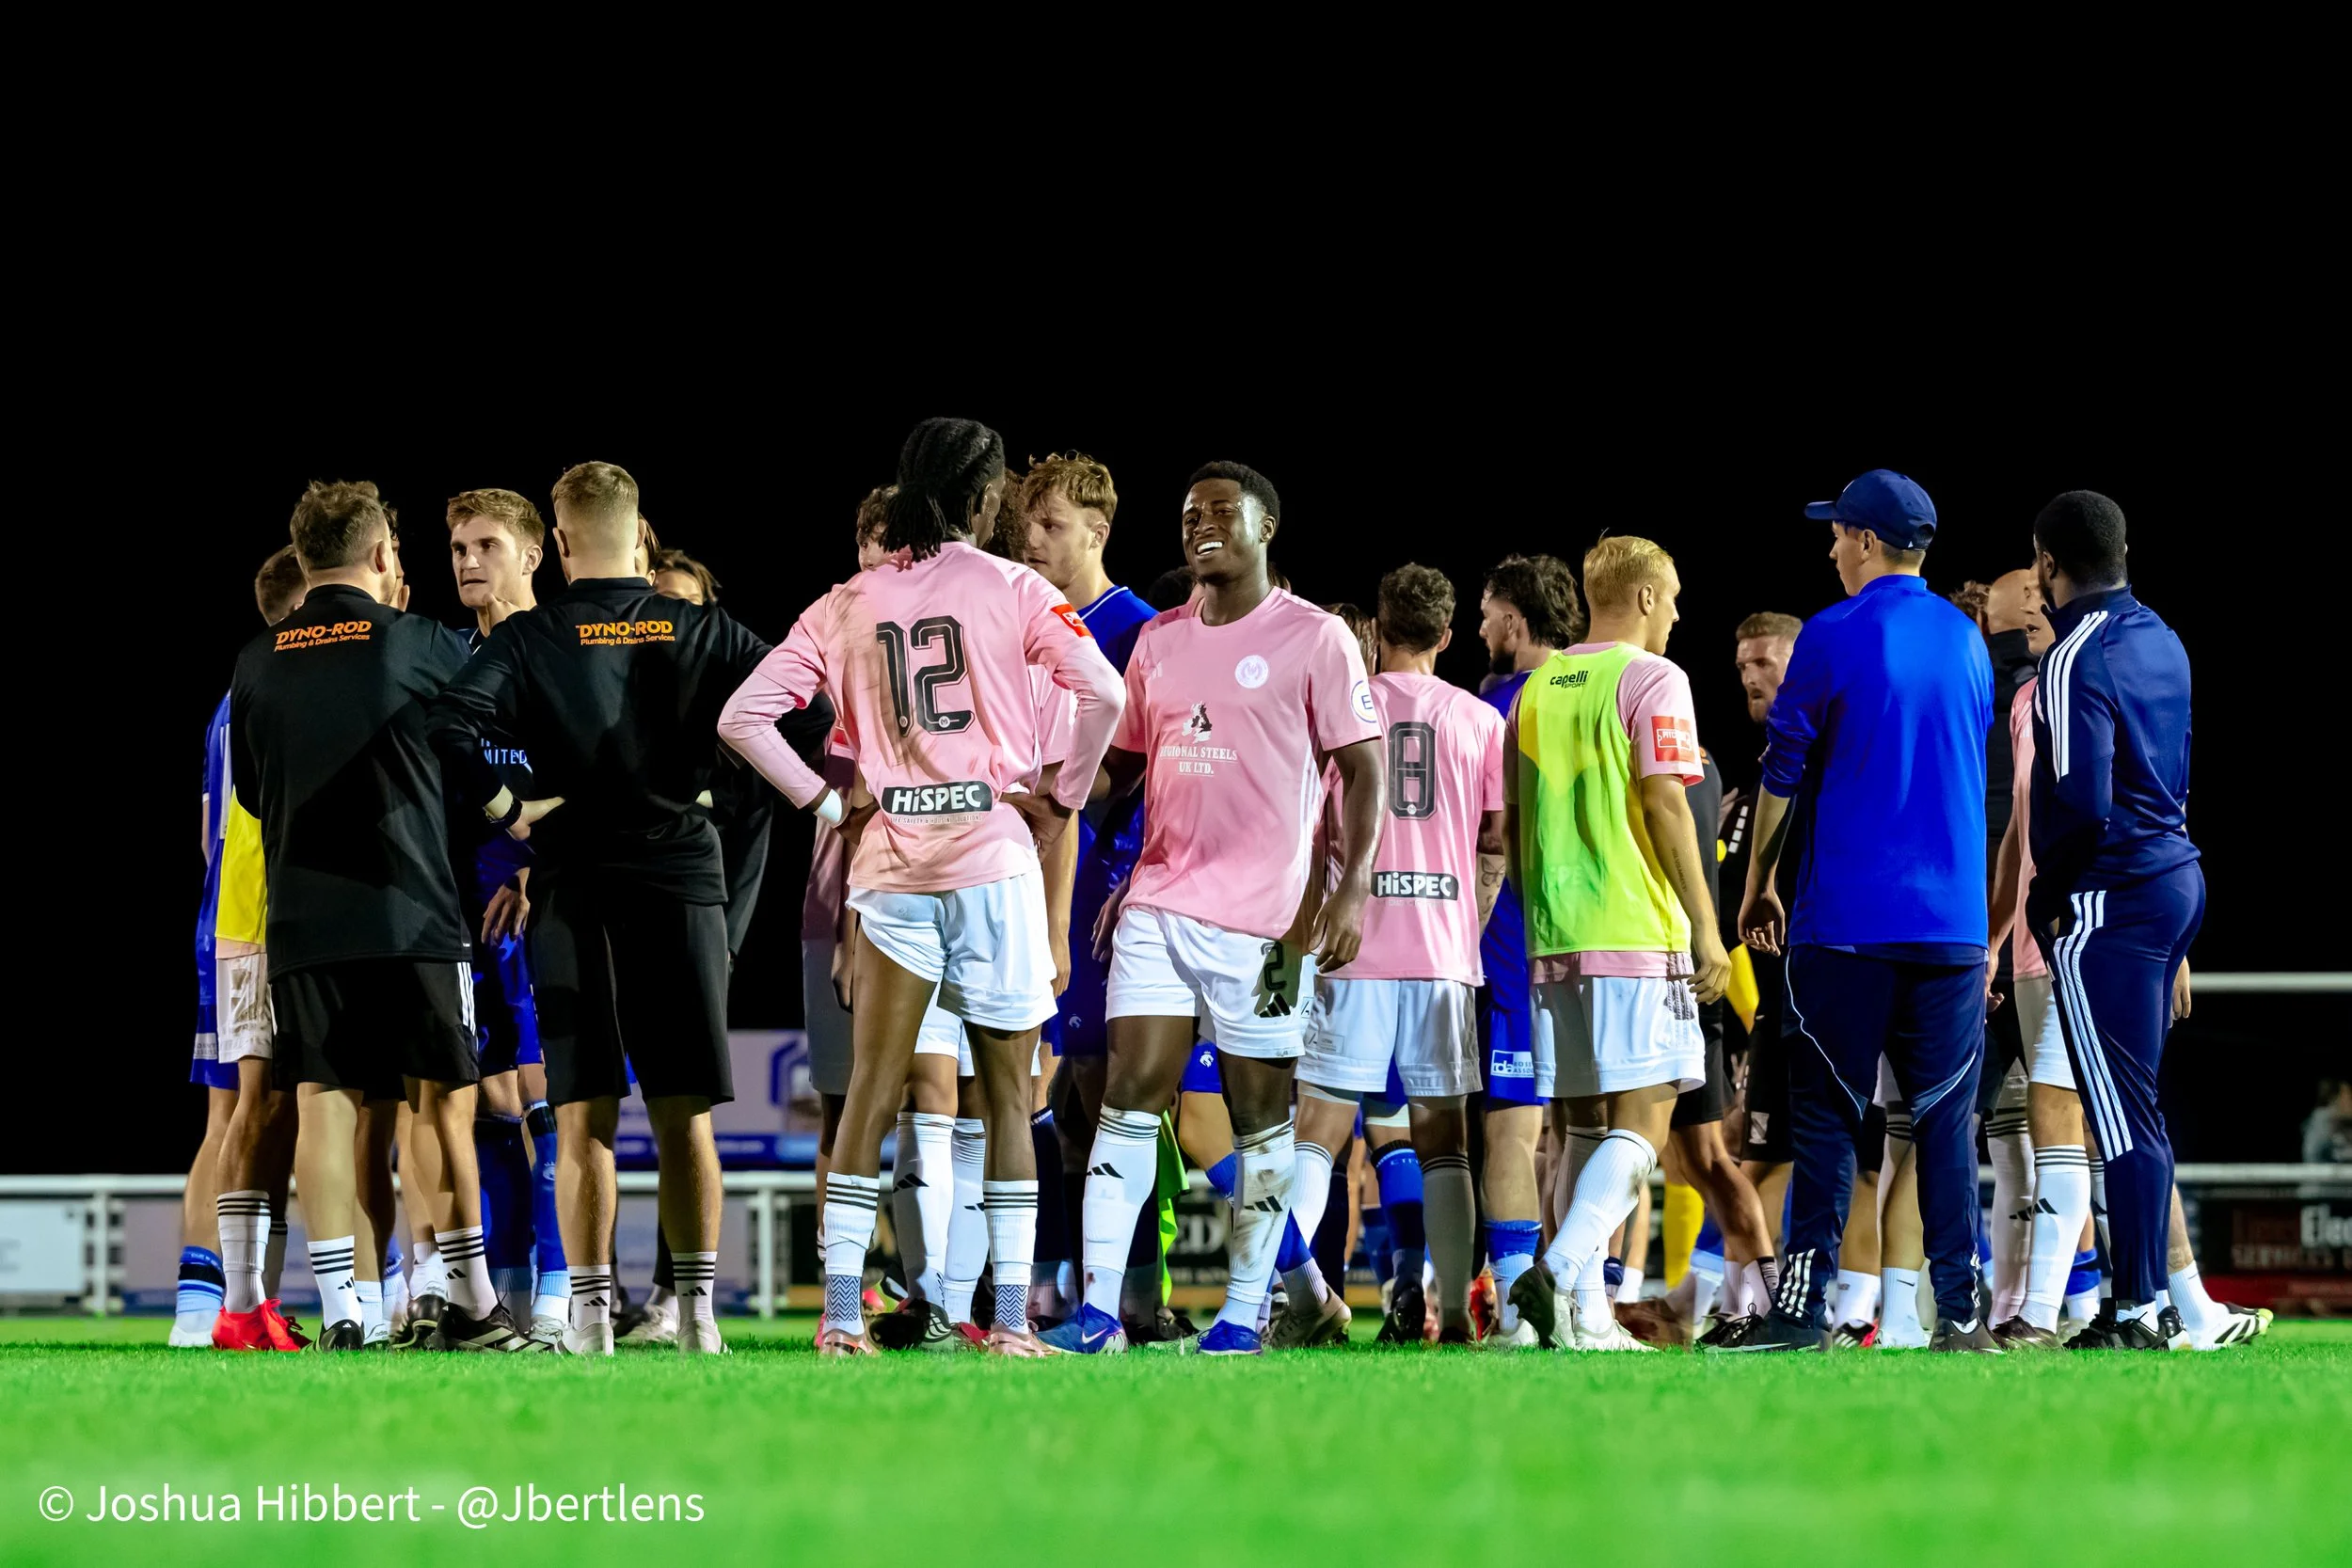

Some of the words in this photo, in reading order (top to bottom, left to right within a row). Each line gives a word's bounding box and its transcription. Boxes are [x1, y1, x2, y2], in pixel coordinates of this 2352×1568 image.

[276, 621, 372, 644] DYNO-ROD
[575, 621, 673, 638] DYNO-ROD
[274, 641, 308, 652] Plumbing
[315, 637, 338, 645] Drains
[623, 636, 644, 644] Drains
[876, 615, 975, 737] 12
[1549, 671, 1589, 688] capelli
[1200, 747, 1238, 761] STEELS
[1179, 762, 1191, 772] UK
[1194, 762, 1214, 774] LTD.
[1389, 721, 1438, 820] 8
[891, 784, 981, 813] HiSPEC
[1377, 872, 1451, 896] HiSPEC
[1261, 941, 1287, 991] 2
